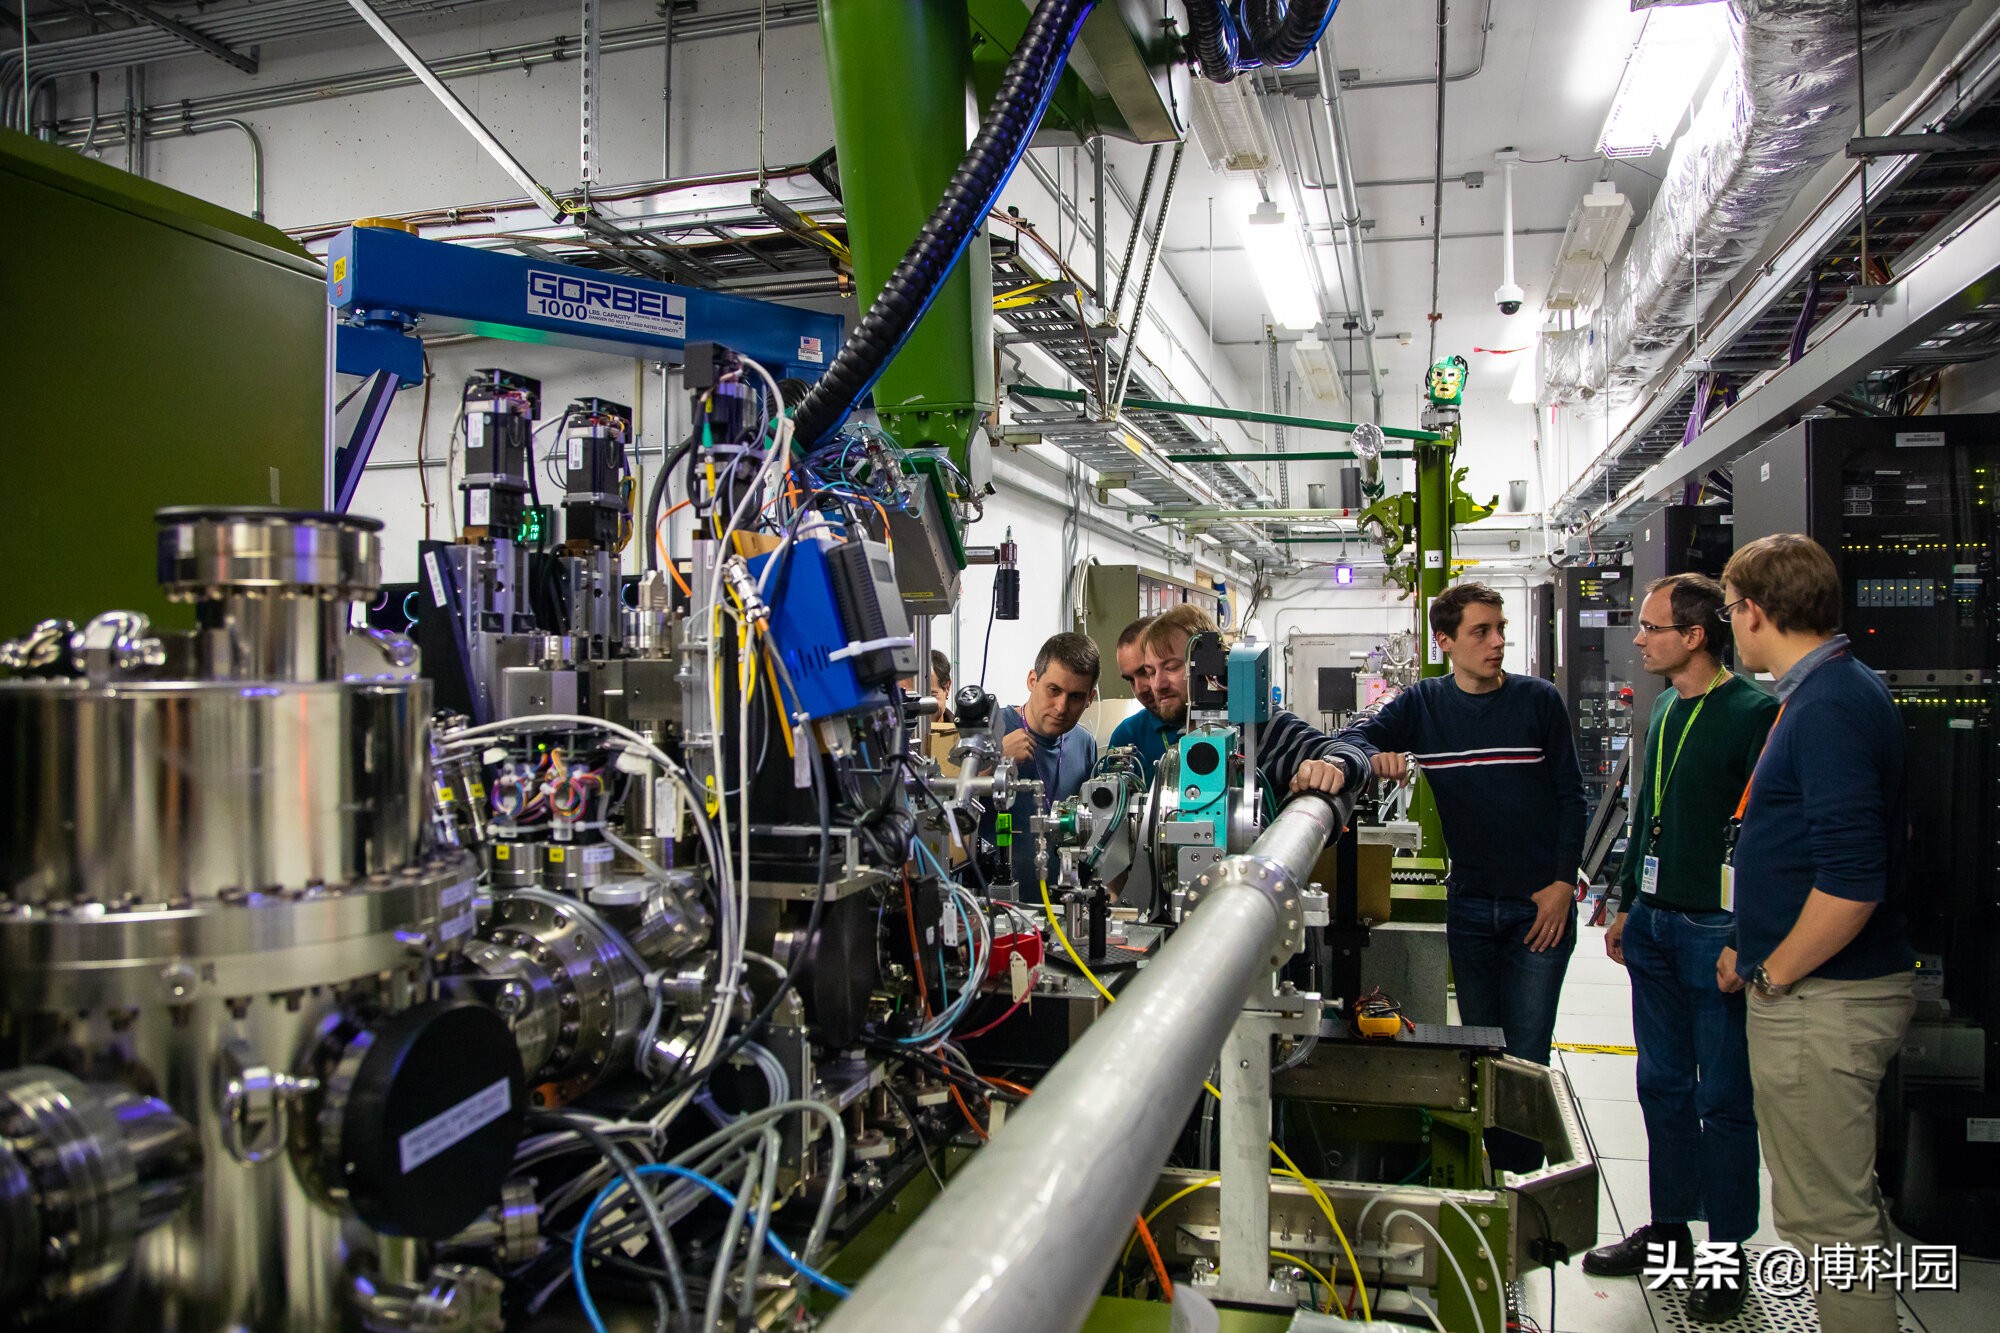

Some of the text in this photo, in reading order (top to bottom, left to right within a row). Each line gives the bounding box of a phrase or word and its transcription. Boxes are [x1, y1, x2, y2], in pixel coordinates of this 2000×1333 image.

[529, 272, 685, 321] GORBEL
[538, 299, 587, 320] 1000
[588, 309, 631, 320] LBS. CAPACITY
